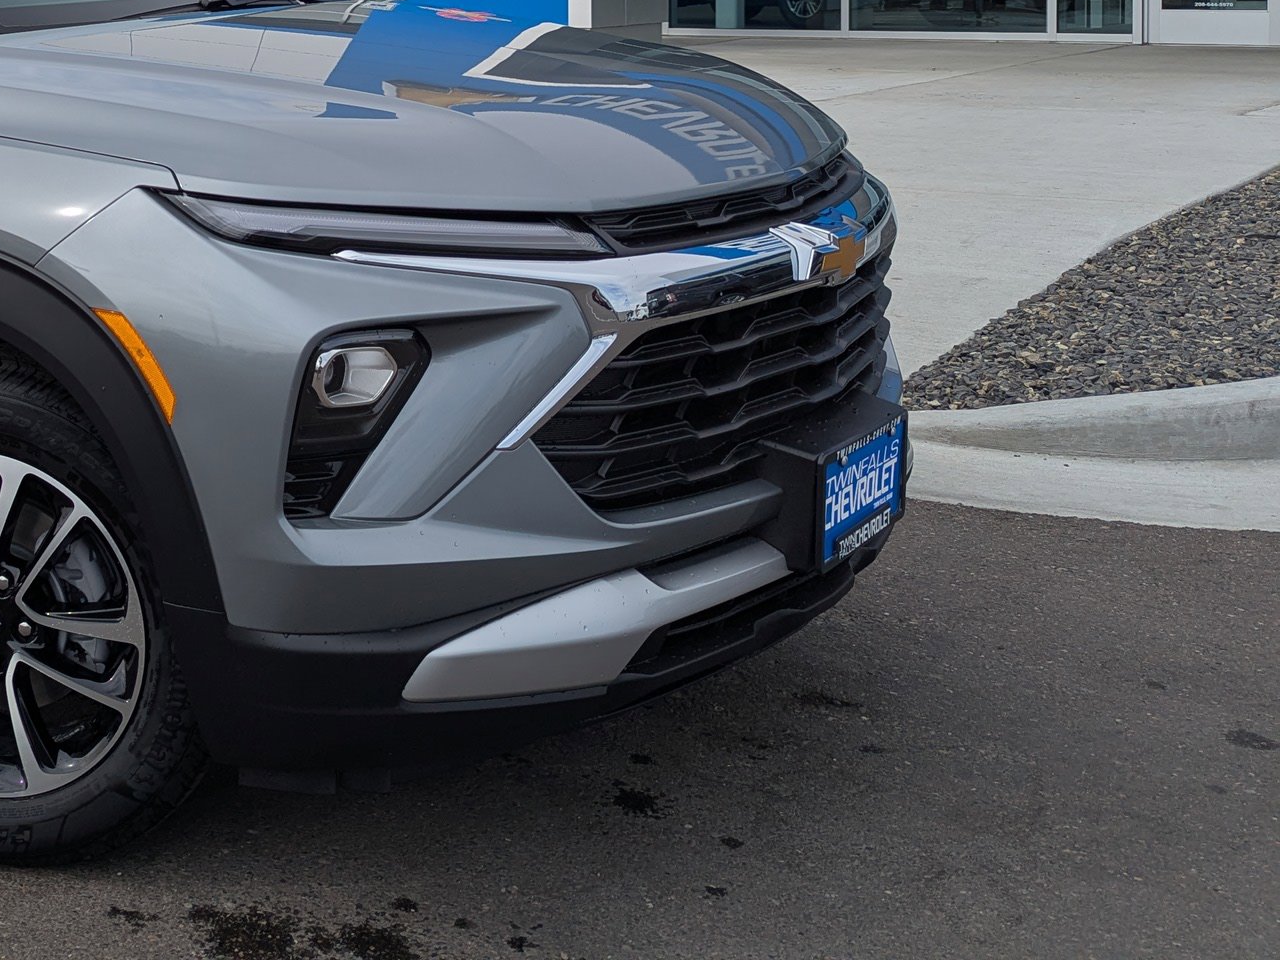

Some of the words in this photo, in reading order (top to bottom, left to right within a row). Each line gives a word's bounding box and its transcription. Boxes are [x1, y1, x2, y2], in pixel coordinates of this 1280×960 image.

[825, 456, 898, 531] CHEVROLET
[826, 439, 900, 498] TWINFALLS
[839, 534, 856, 552] TWIN
[854, 507, 891, 548] CHEVROLET
